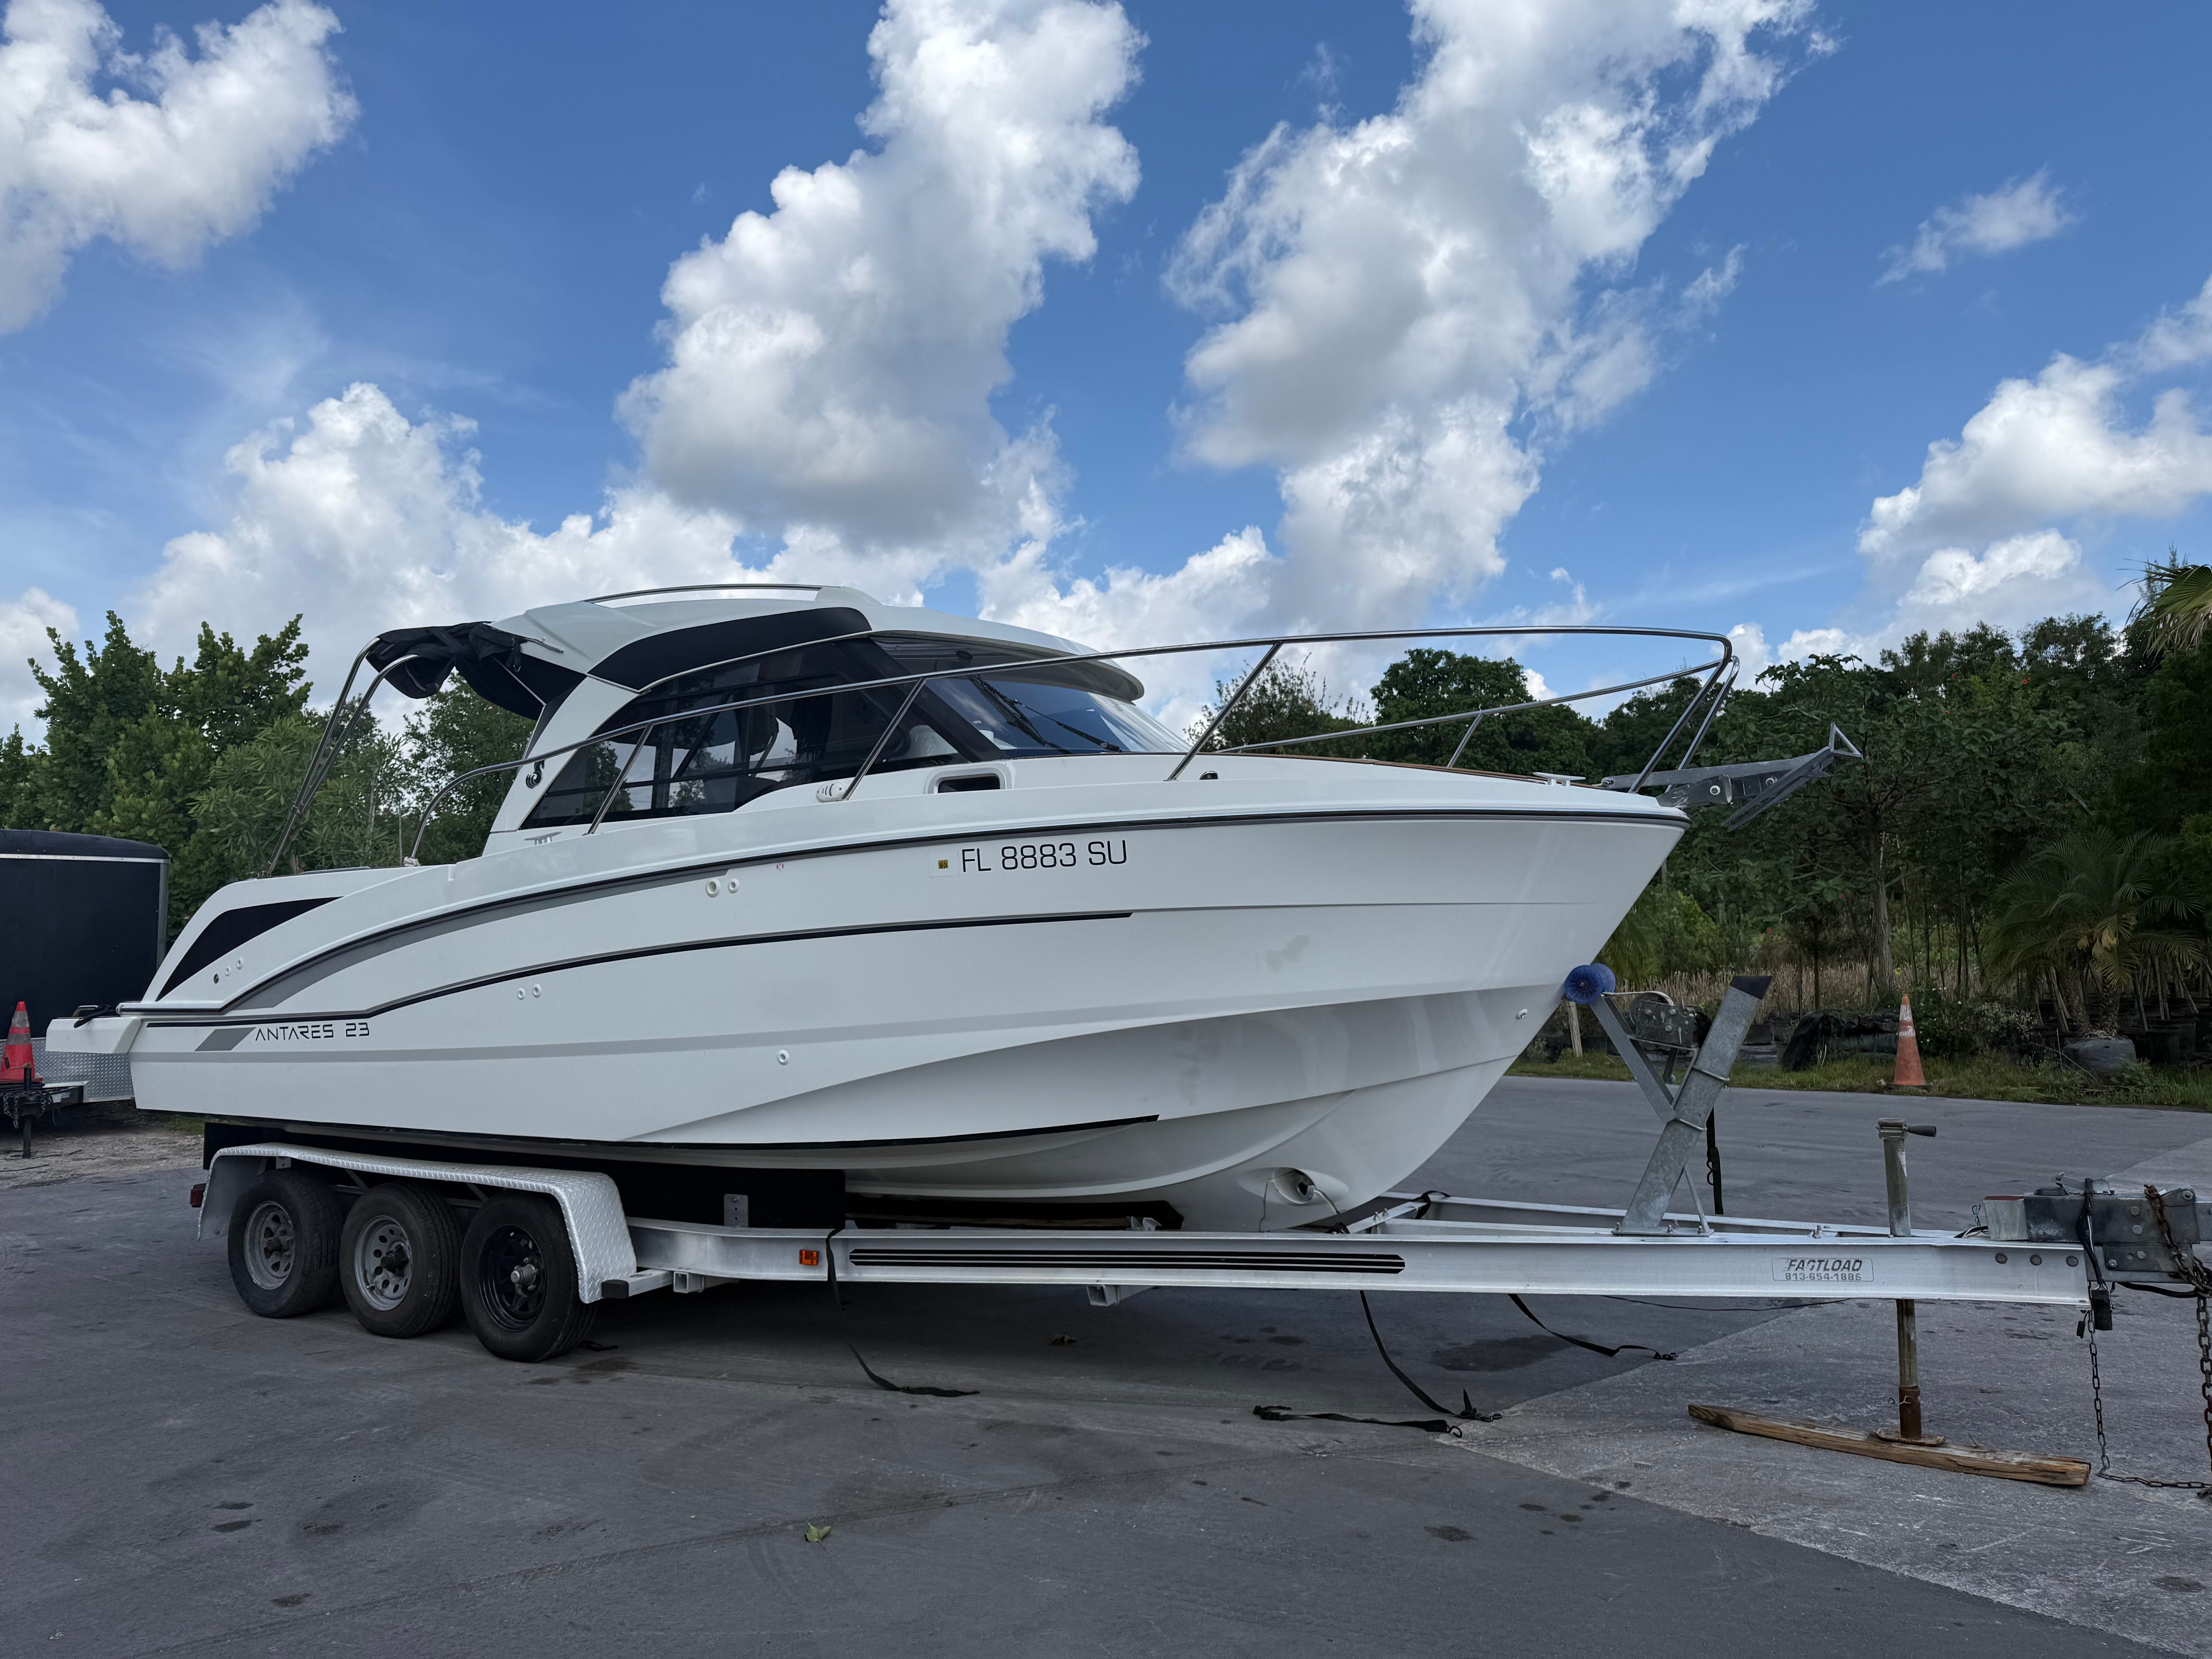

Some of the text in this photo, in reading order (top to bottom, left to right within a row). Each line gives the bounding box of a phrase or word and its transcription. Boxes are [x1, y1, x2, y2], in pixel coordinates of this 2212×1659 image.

[962, 840, 1127, 872] FL 8883 SU
[256, 1022, 370, 1041] ANTARES 23
